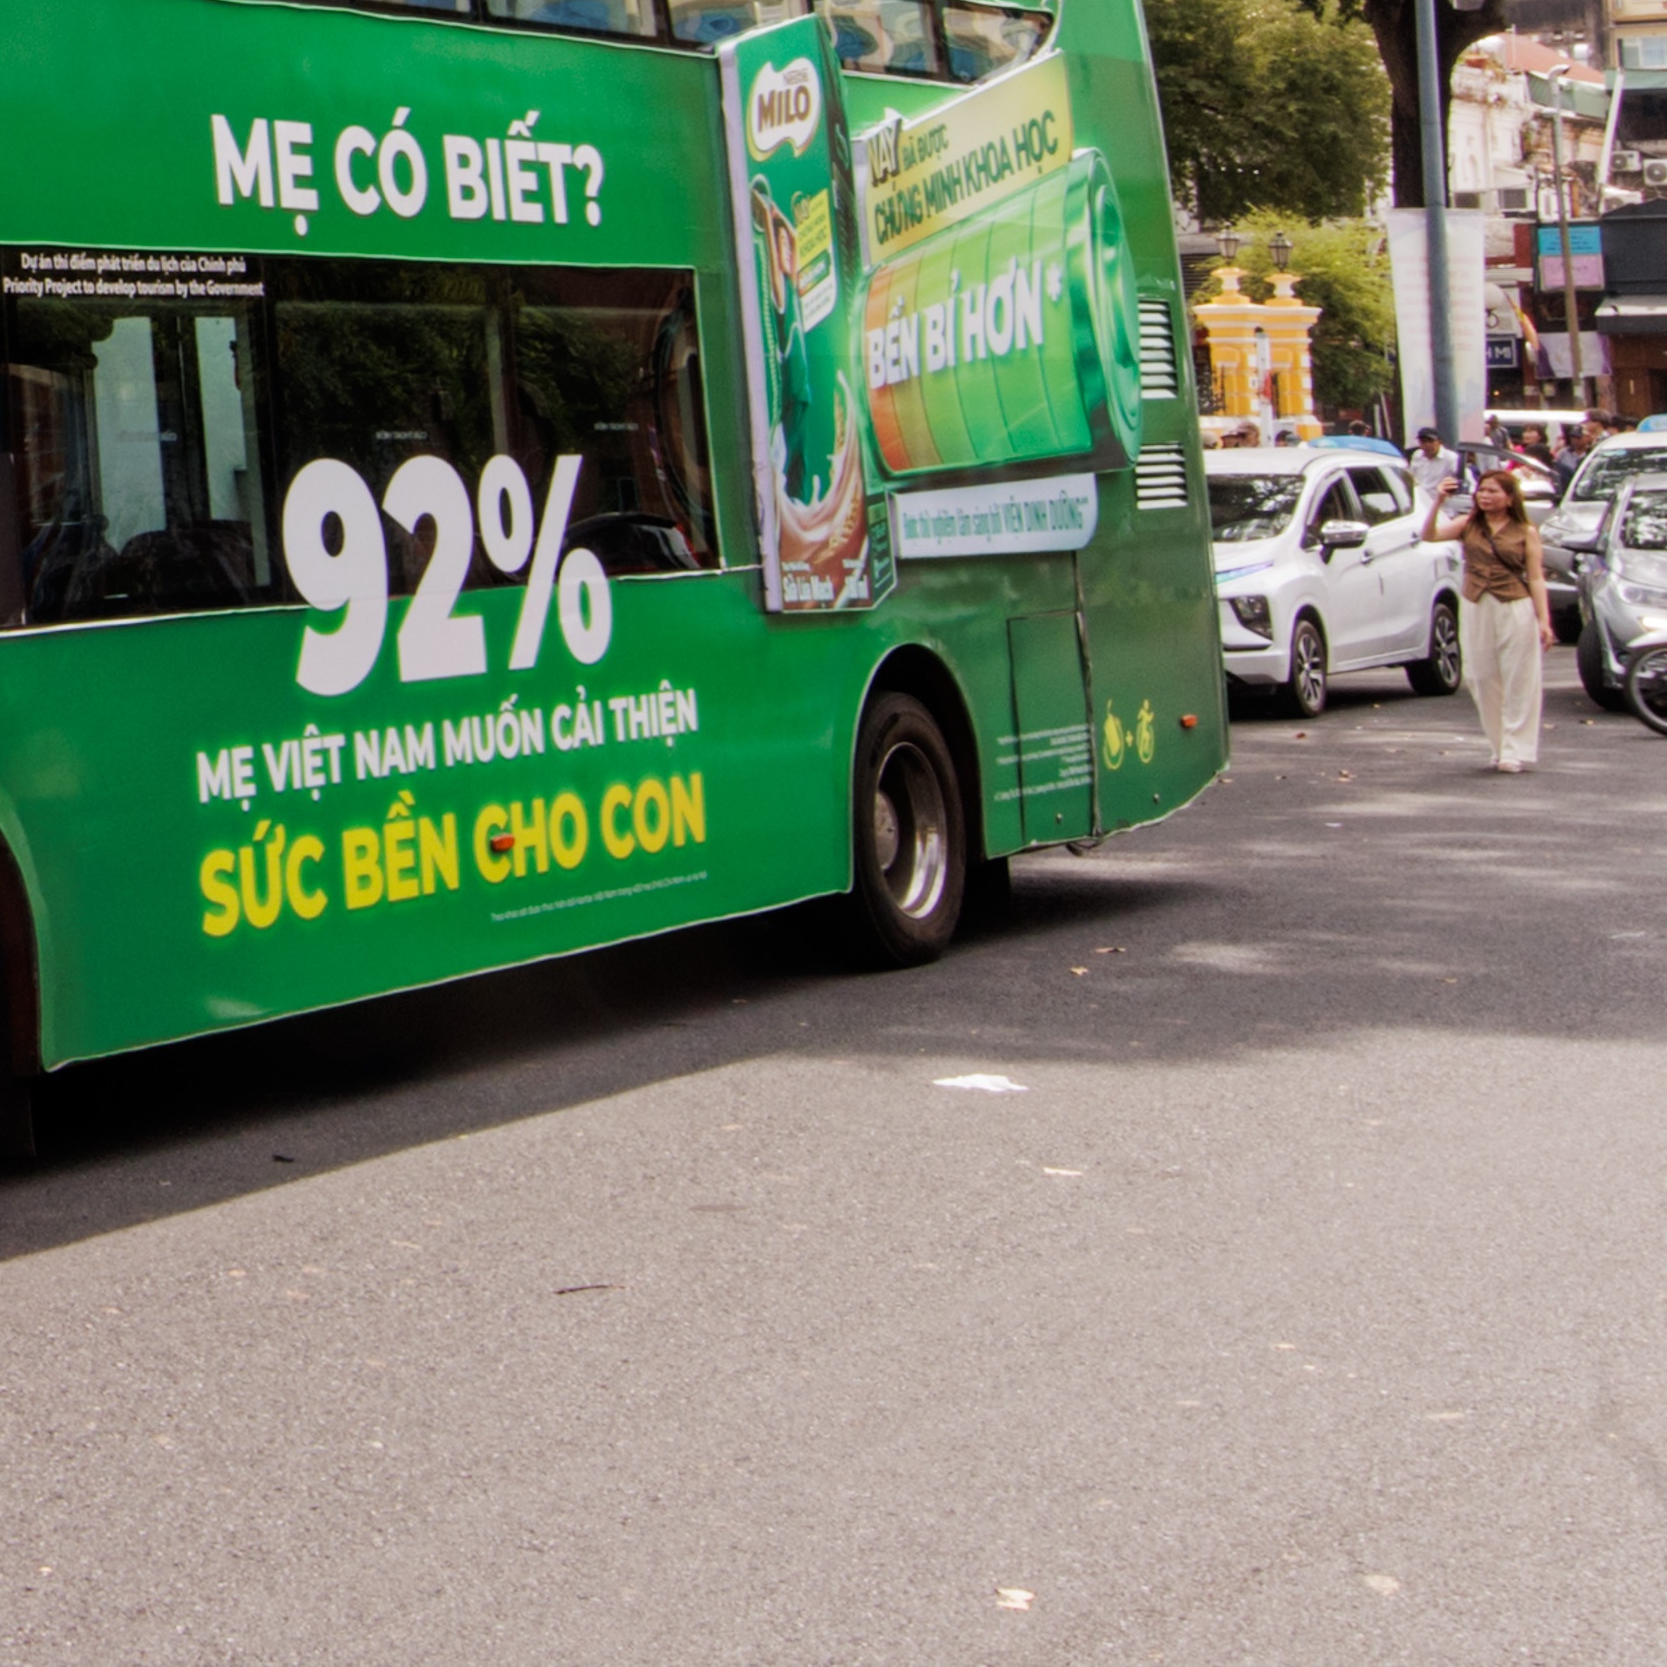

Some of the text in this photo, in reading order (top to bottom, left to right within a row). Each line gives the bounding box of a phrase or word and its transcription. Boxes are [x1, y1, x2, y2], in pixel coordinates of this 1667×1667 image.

[757, 84, 811, 133] MILO
[869, 118, 903, 188] NAY
[210, 106, 604, 236] MẸ CÓ BIẾT?
[874, 180, 924, 246] CHỨNG
[922, 159, 964, 219] MINH
[961, 135, 1015, 199] KHOA
[1012, 109, 1059, 175] HỌC
[3, 276, 265, 299] Priority Project to develop tourism by the Government
[21, 252, 38, 273] Dự
[38, 252, 53, 270] án
[97, 254, 121, 274] phát
[147, 255, 160, 272] du
[180, 255, 198, 272] của
[198, 256, 226, 272] Chính
[227, 256, 246, 276] phủ
[866, 295, 921, 389] BỀN
[922, 269, 957, 374] BỈ
[282, 452, 613, 696] 92%
[1024, 500, 1049, 532] DINH
[196, 679, 700, 813] MẸ VIỆT NAM MUỐN CẢI THIỆN
[199, 819, 328, 937] SỨC
[342, 790, 460, 911] BỀN
[473, 792, 589, 884] CHO
[599, 771, 707, 861] CON
